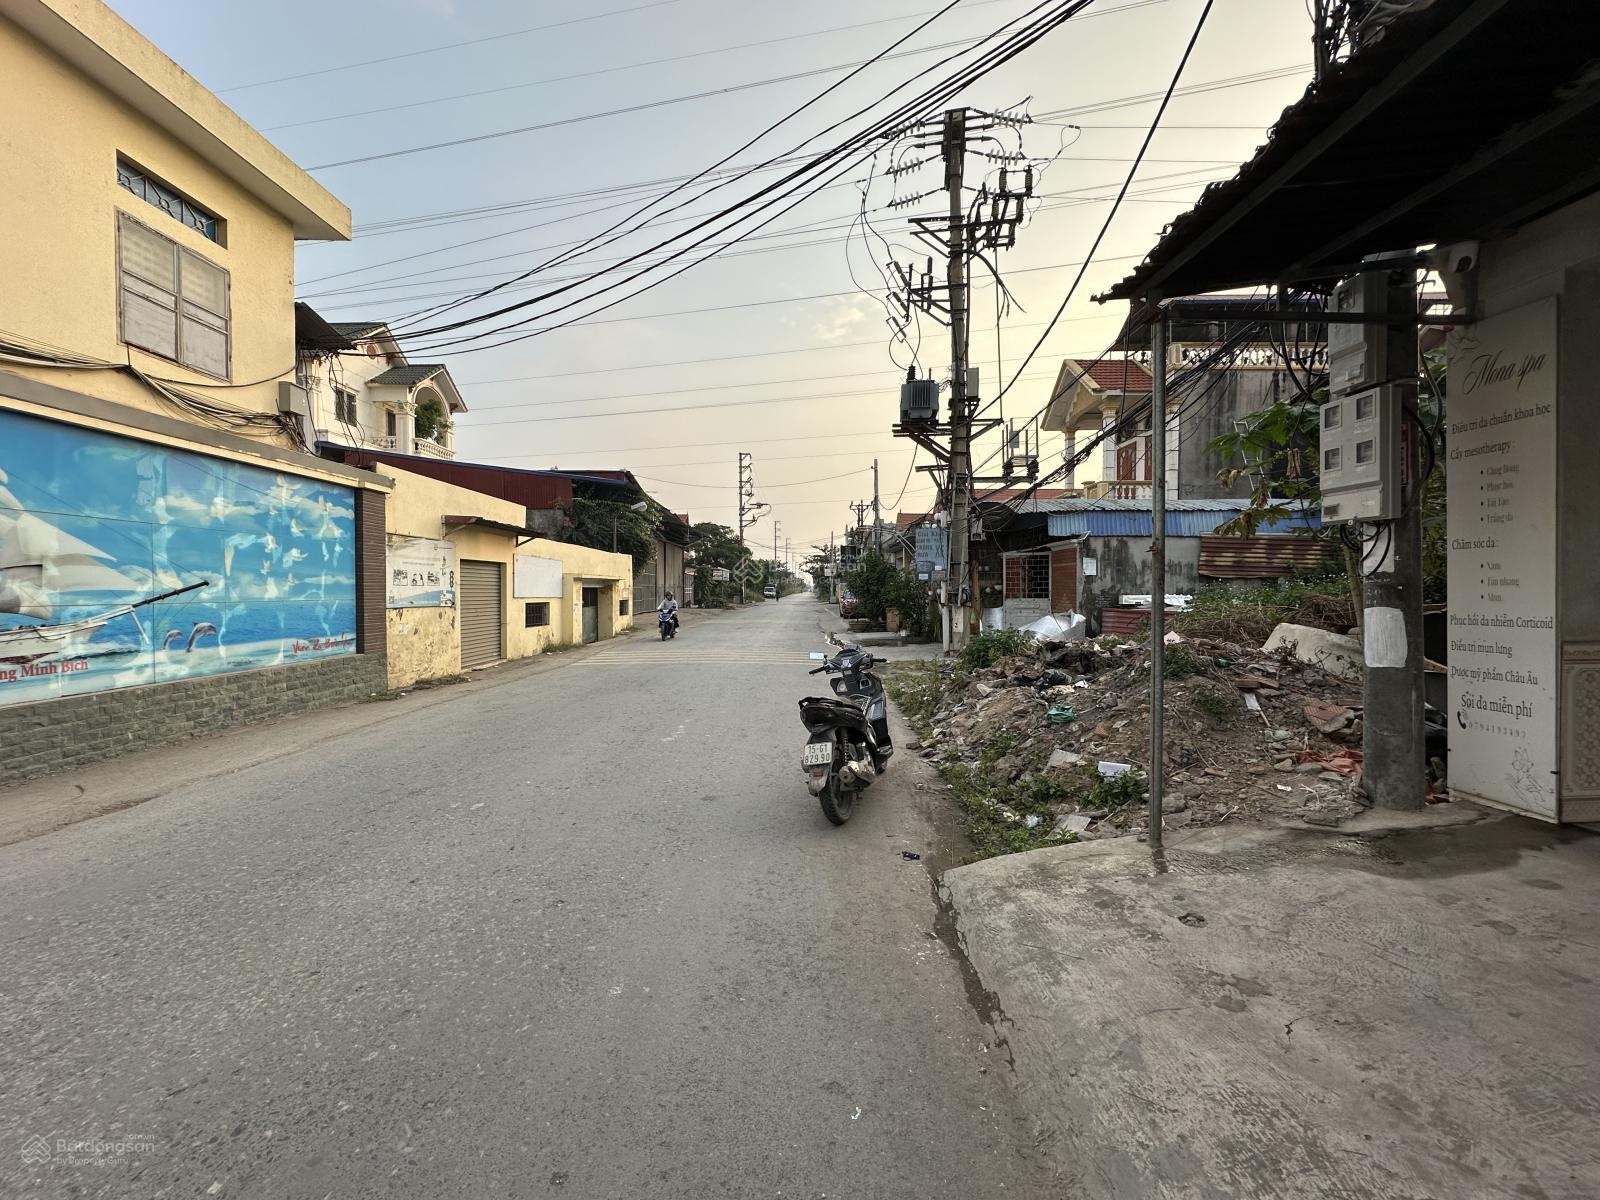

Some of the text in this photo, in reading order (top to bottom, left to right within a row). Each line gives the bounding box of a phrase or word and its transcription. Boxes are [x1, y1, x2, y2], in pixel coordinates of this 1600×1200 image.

[1479, 416, 1488, 428] da
[1514, 407, 1534, 421] khoa
[1480, 614, 1489, 627] da
[1516, 616, 1553, 630] Corticoid
[20, 661, 57, 678] Minh
[1489, 696, 1515, 715] miễn
[1515, 700, 1533, 720] phí
[804, 753, 830, 763] 829.90
